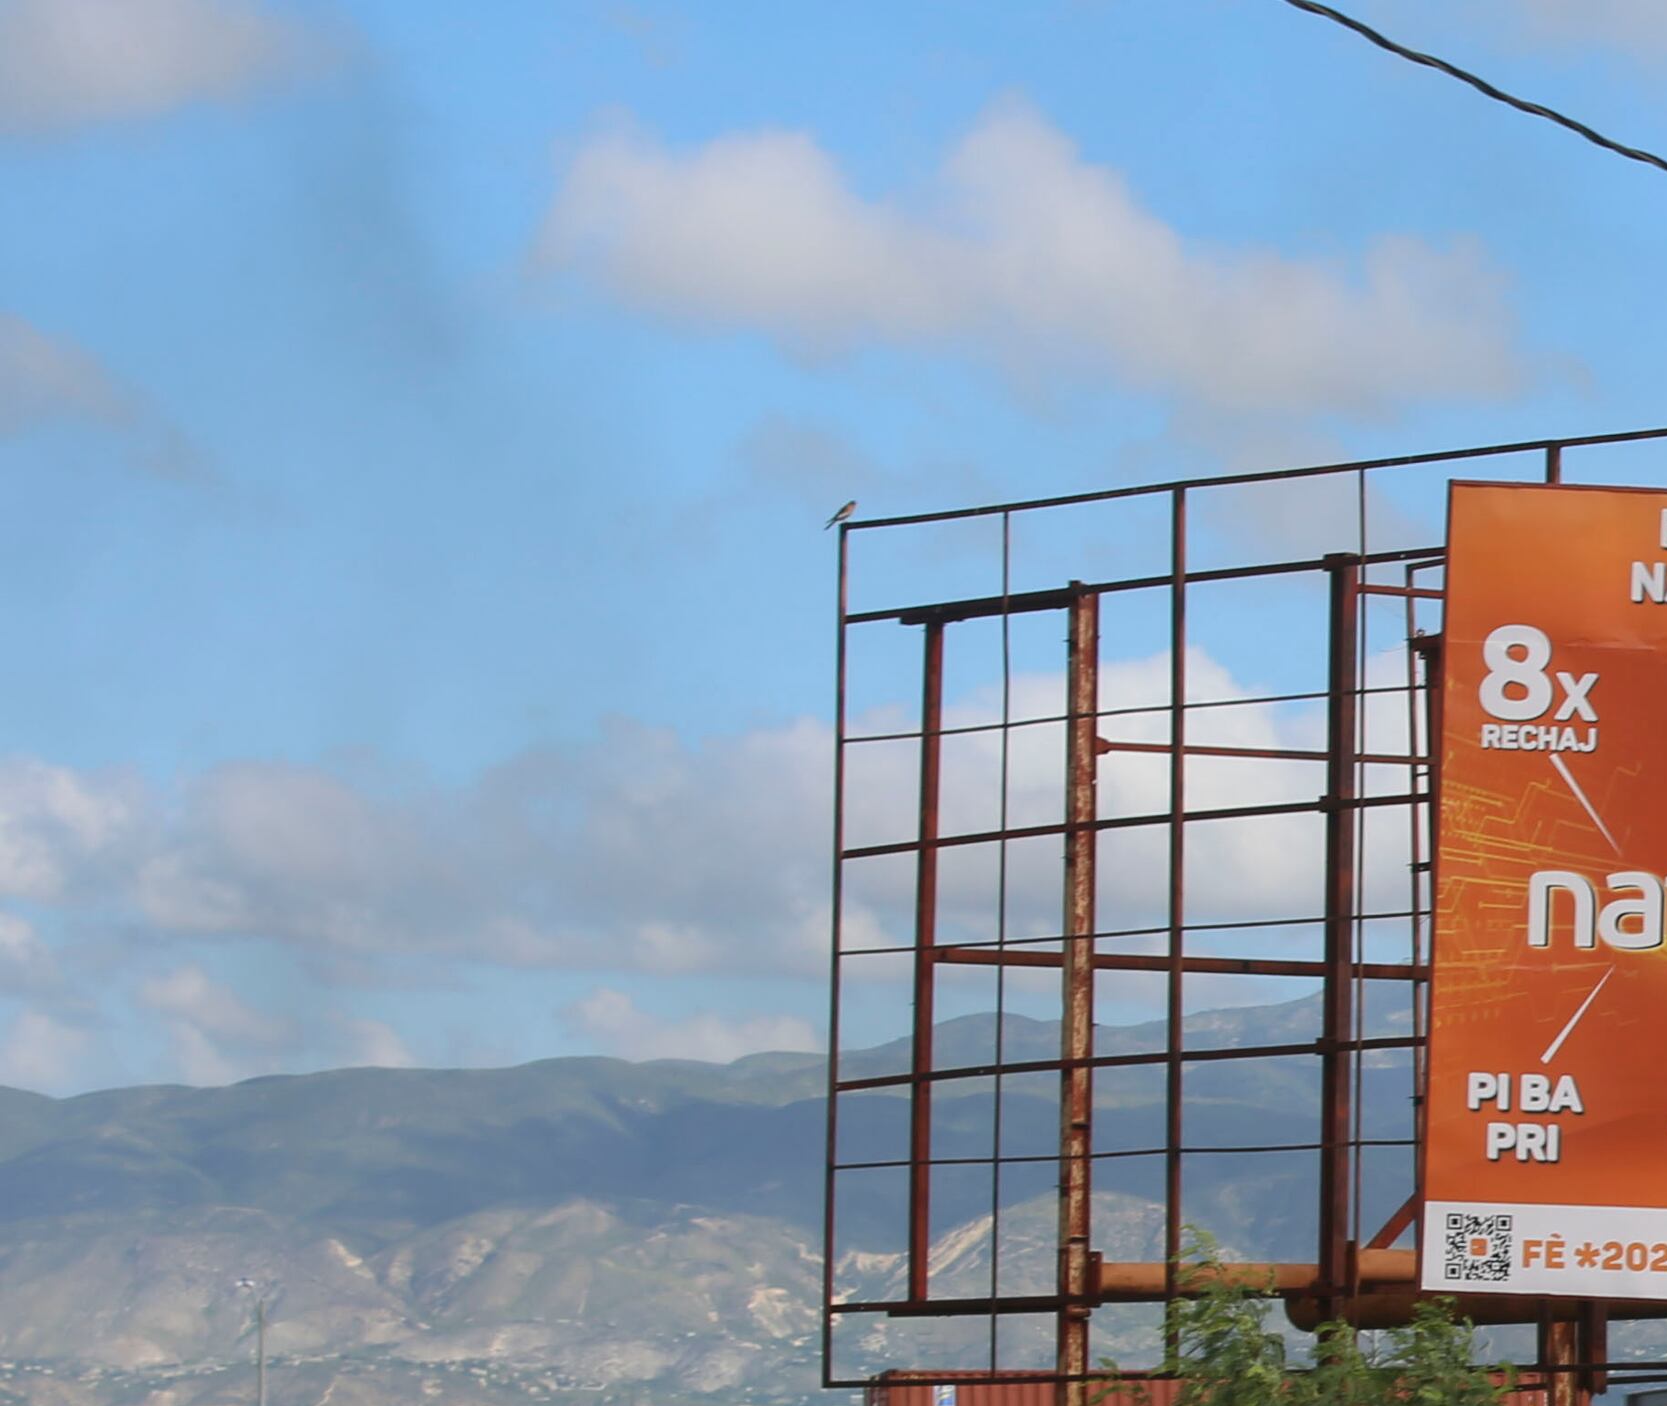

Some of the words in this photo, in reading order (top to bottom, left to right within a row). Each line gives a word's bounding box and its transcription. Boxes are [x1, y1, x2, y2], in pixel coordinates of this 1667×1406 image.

[1479, 624, 1600, 722] 8x
[1481, 723, 1598, 753] RECHAJ
[1467, 1072, 1511, 1112] PI
[1519, 1073, 1584, 1114] BA
[1487, 1122, 1560, 1163] PRI
[1522, 1232, 1565, 1269] FÈ
